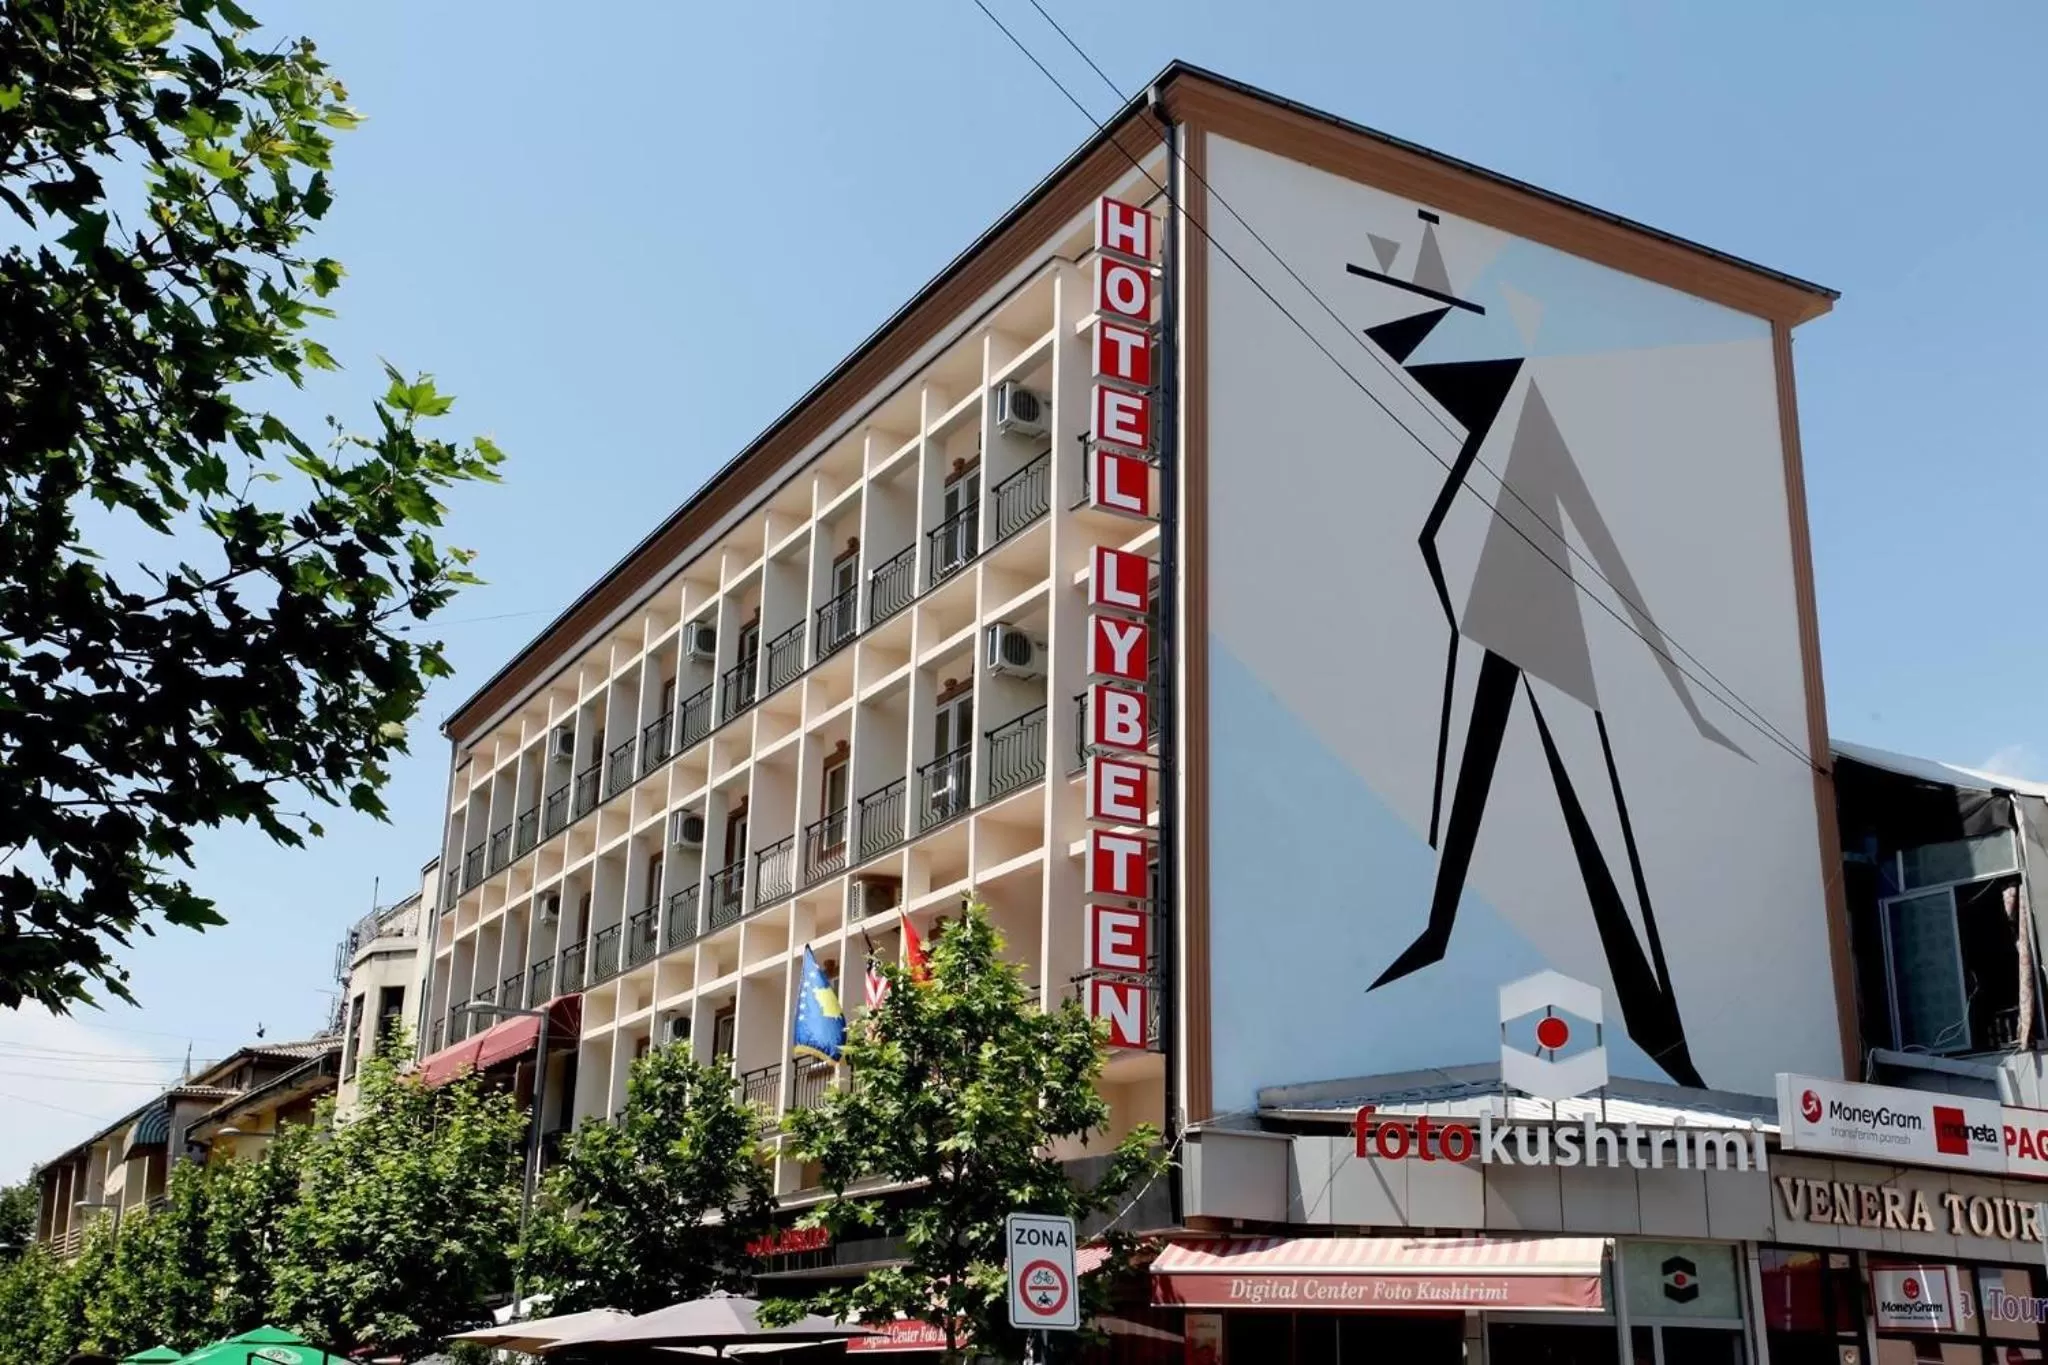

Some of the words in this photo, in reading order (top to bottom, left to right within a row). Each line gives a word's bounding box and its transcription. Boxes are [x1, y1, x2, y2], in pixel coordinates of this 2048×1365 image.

[1103, 202, 1147, 512] HOTEL
[1099, 552, 1143, 1044] LYBETEN
[1829, 1100, 1922, 1130] MoneyGram
[1942, 1122, 1998, 1143] moneta
[1775, 1175, 1936, 1233] VENERA
[1015, 1227, 1068, 1248] ZONA
[1230, 1279, 1298, 1303] Digital
[1303, 1279, 1369, 1300] Center
[1373, 1279, 1412, 1300] Foto
[1416, 1279, 1509, 1301] Kushtrimi
[1881, 1301, 1944, 1315] MoneyGram
[892, 1325, 920, 1344] Center
